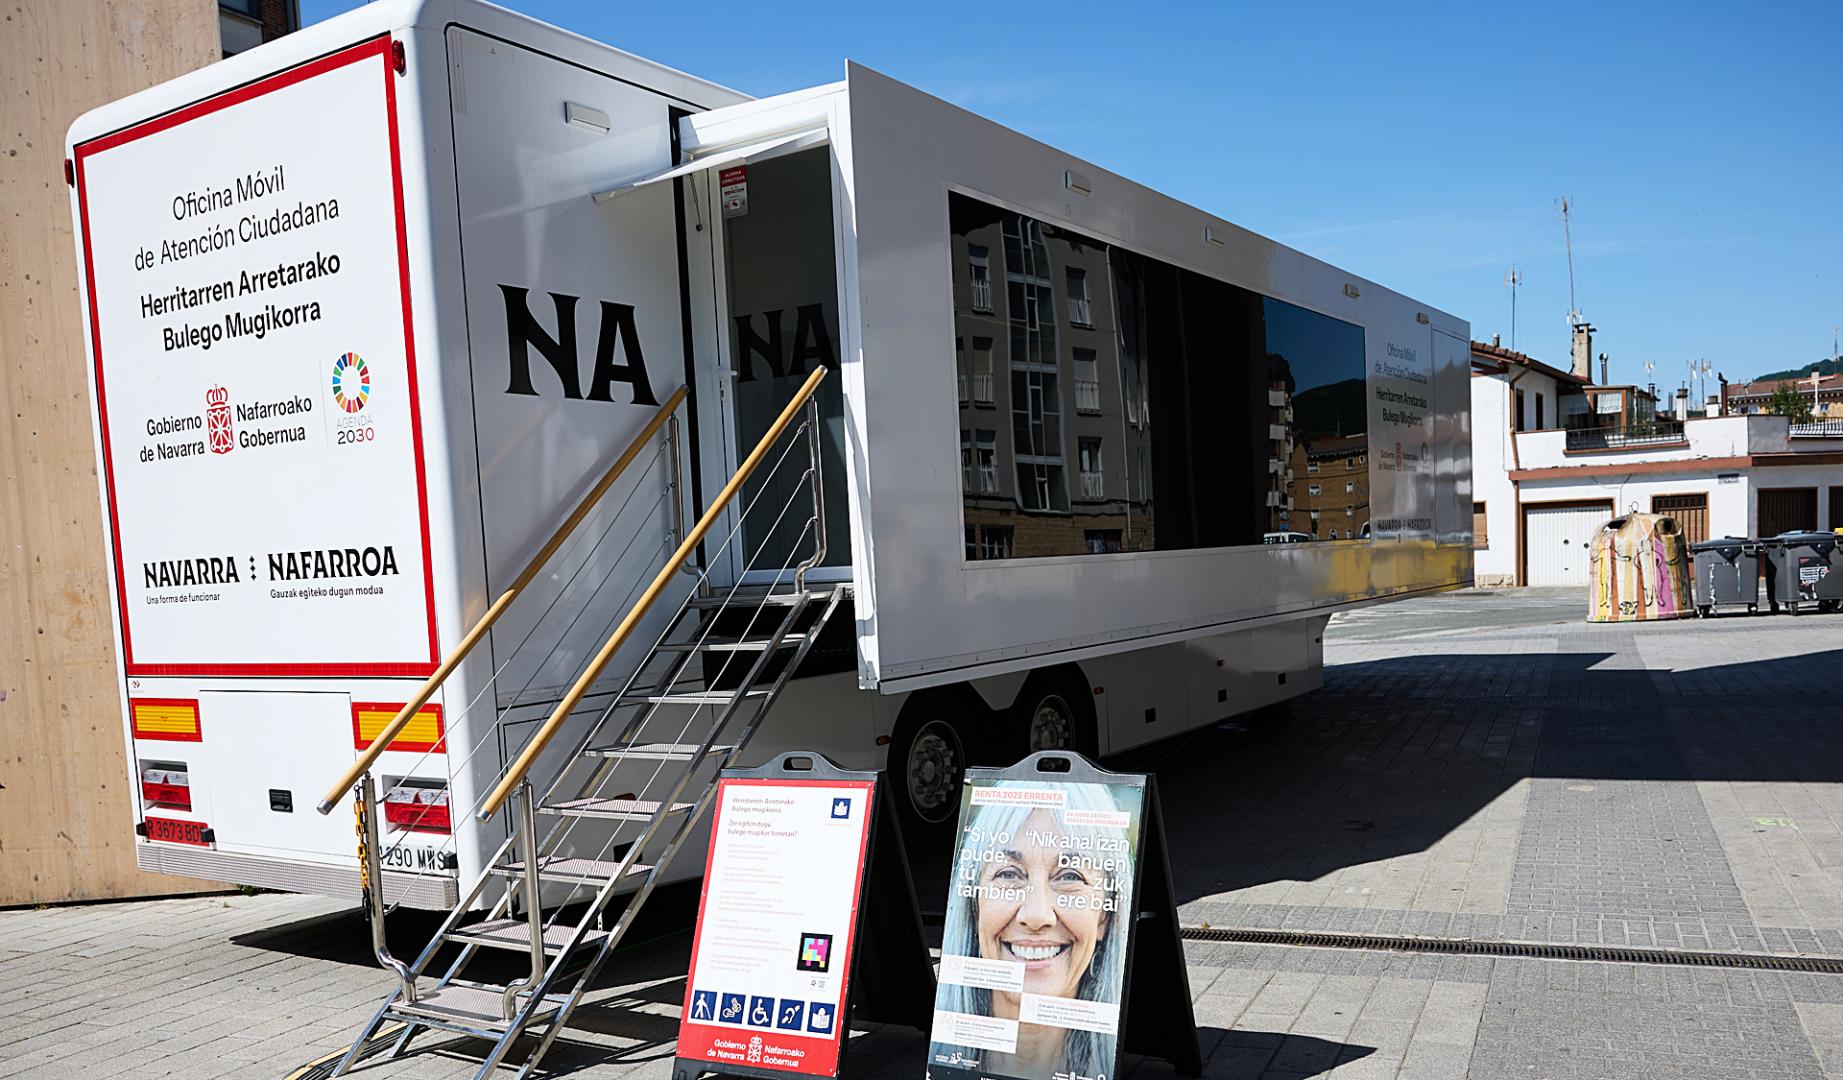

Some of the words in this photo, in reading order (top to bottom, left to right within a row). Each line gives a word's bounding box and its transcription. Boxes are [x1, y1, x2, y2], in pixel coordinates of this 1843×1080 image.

[173, 189, 233, 221] Oficina
[237, 165, 285, 205] Móvil
[135, 247, 155, 271] de
[160, 225, 235, 266] Atención
[239, 199, 339, 244] Ciudadana
[140, 282, 234, 319] Herritarren
[239, 251, 341, 296] Arretarako
[163, 320, 223, 352] Bulego
[225, 301, 321, 340] Mugikorra
[497, 283, 660, 406] NA
[236, 395, 312, 422] Nafarroako
[146, 413, 202, 436] Gobierno
[336, 415, 374, 428] AGENDA
[239, 425, 306, 449] Gobernua
[337, 427, 375, 445] 2030
[140, 446, 154, 463] de
[157, 440, 205, 461] Navarra
[143, 556, 240, 589] NAVARRA
[268, 546, 400, 581] NAFARROA
[146, 596, 159, 605] Una
[160, 594, 178, 604] forma
[179, 594, 188, 603] de
[188, 592, 221, 602] funcionar
[270, 588, 297, 598] Gauzak
[299, 587, 327, 599] egiteko
[328, 586, 354, 598] dugun
[355, 585, 384, 596] modua
[975, 789, 1001, 799] RENTA
[1002, 791, 1022, 800] 2025
[1024, 792, 1063, 801] ERRENTA
[988, 831, 1009, 848] yo
[1060, 833, 1094, 850] ahal
[1097, 834, 1130, 852] izan
[960, 847, 1008, 866] pude,
[960, 864, 975, 880] tú
[1094, 875, 1125, 892] zuk
[1056, 894, 1086, 909] ere
[714, 1038, 746, 1050] Gobierno
[764, 1045, 805, 1058] Nafarroako
[707, 1048, 716, 1057] de
[717, 1050, 745, 1060] Navarra
[763, 1055, 799, 1067] Gobernua
